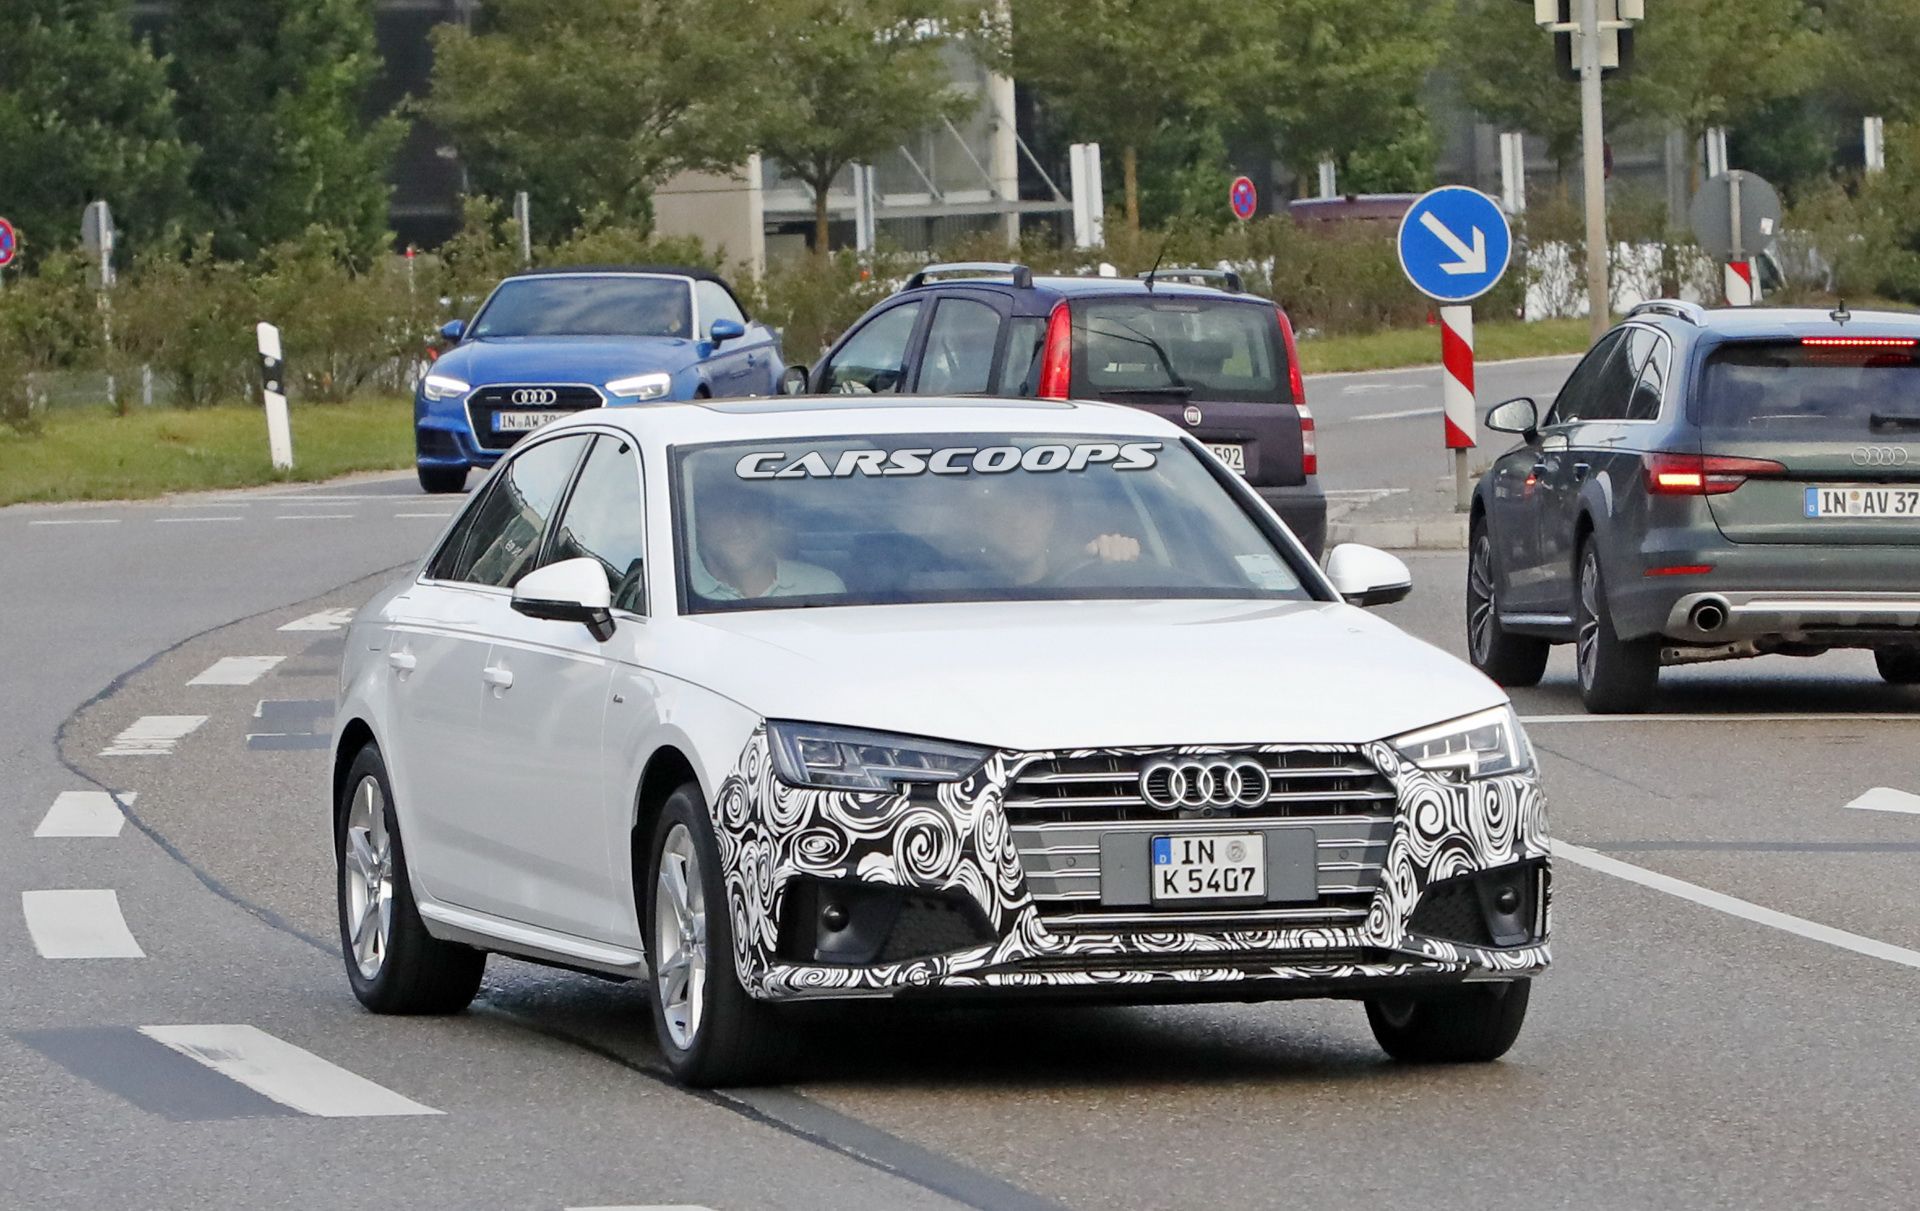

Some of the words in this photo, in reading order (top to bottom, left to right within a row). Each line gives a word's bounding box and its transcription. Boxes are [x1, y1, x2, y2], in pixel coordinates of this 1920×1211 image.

[502, 415, 515, 428] IN
[1822, 492, 1847, 513] IN
[1863, 492, 1888, 513] AV
[1894, 492, 1919, 513] 37
[1160, 855, 1167, 863] D
[1181, 840, 1214, 864] IN
[1163, 870, 1179, 894] K
[1188, 867, 1256, 893] 5407
